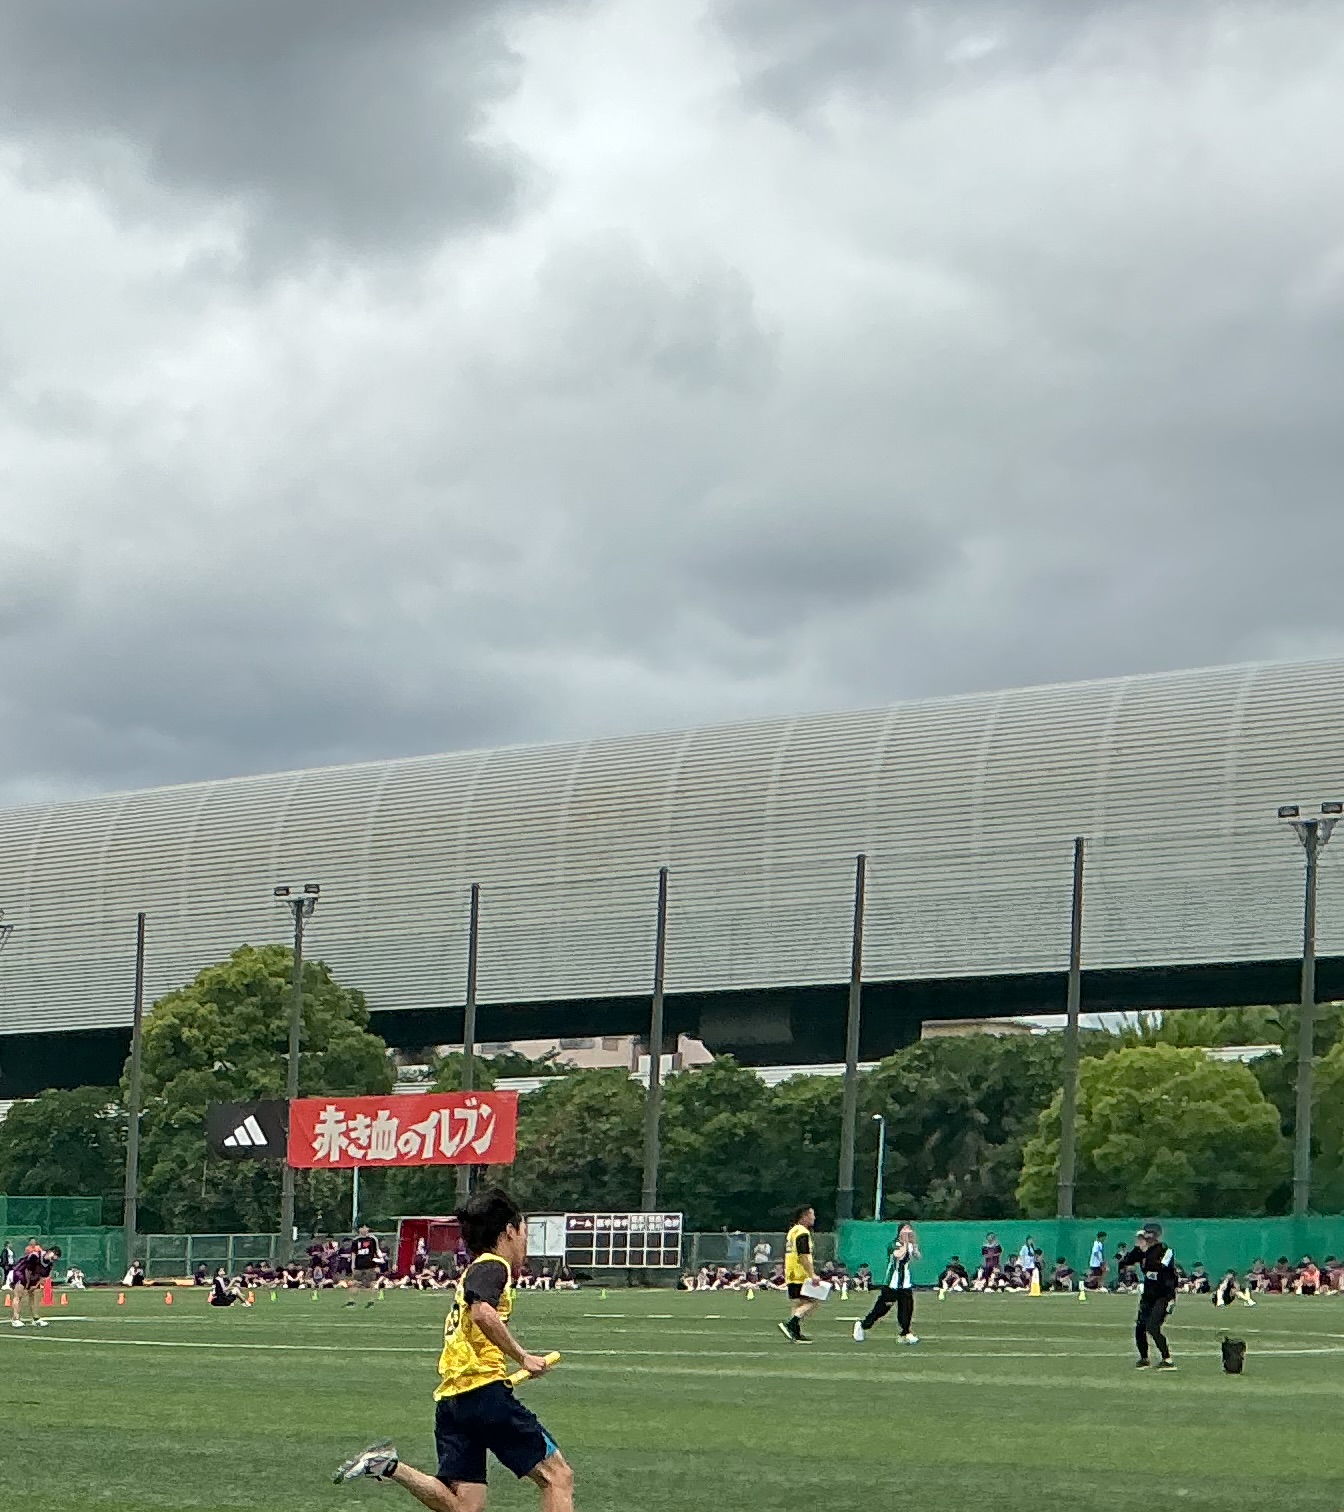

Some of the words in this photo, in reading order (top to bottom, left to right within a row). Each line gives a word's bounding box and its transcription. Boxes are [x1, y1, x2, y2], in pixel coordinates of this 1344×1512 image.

[312, 1097, 496, 1162] 赤き血のイレブン
